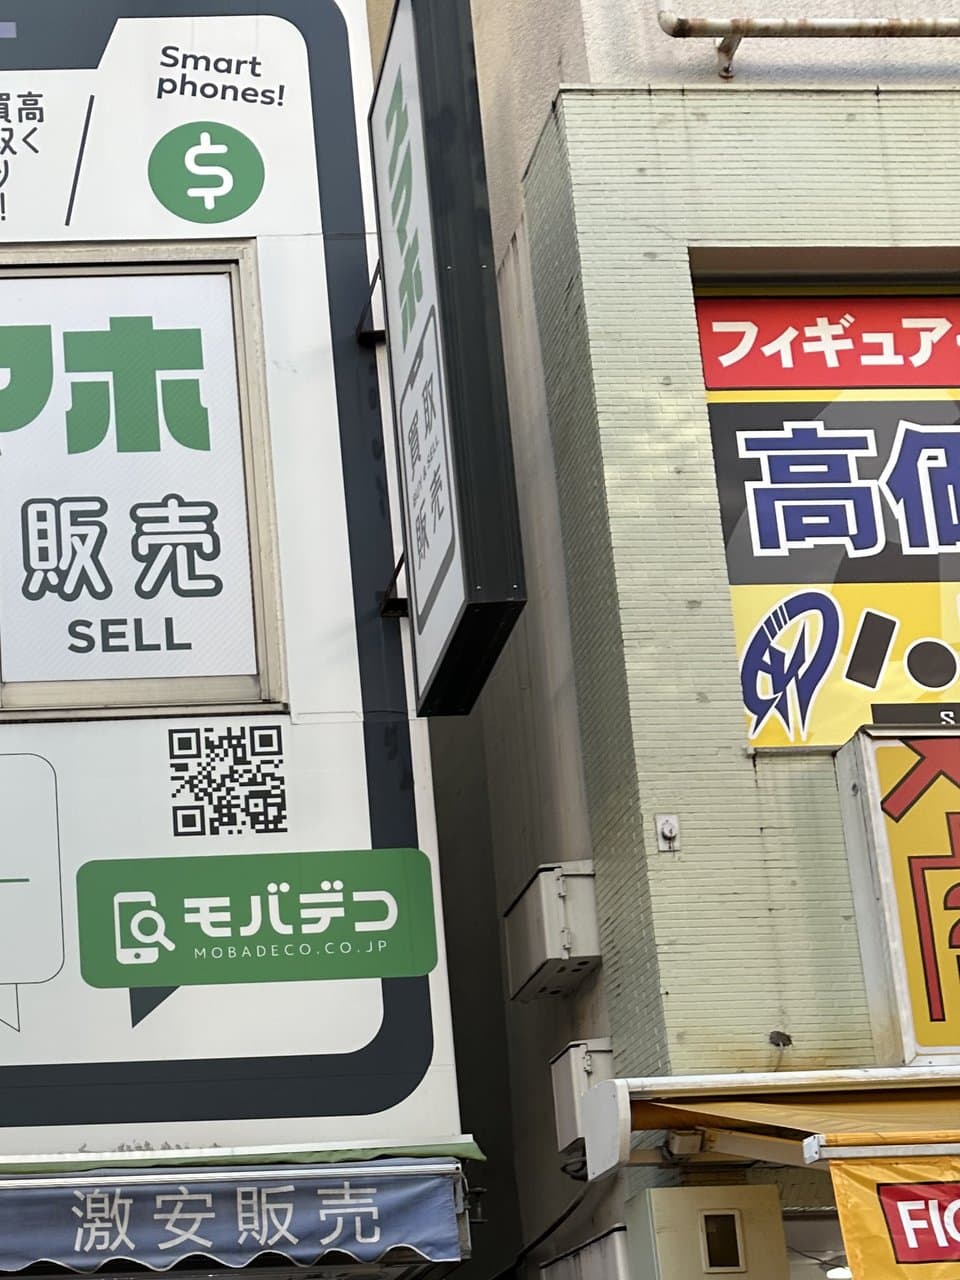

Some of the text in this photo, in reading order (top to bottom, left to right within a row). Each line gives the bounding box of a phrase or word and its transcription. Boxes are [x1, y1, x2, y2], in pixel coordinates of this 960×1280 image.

[159, 45, 262, 77] Smart
[156, 73, 286, 107] phones!
[16, 91, 44, 154] 高く
[385, 63, 423, 353] スマホ
[711, 313, 960, 369] フィギュア
[21, 493, 224, 602] 販売
[68, 617, 193, 654] SELL
[183, 880, 399, 938] モバデコ
[194, 940, 388, 960] MOBADECO.CO.JP
[72, 1180, 384, 1253] 激安販売
